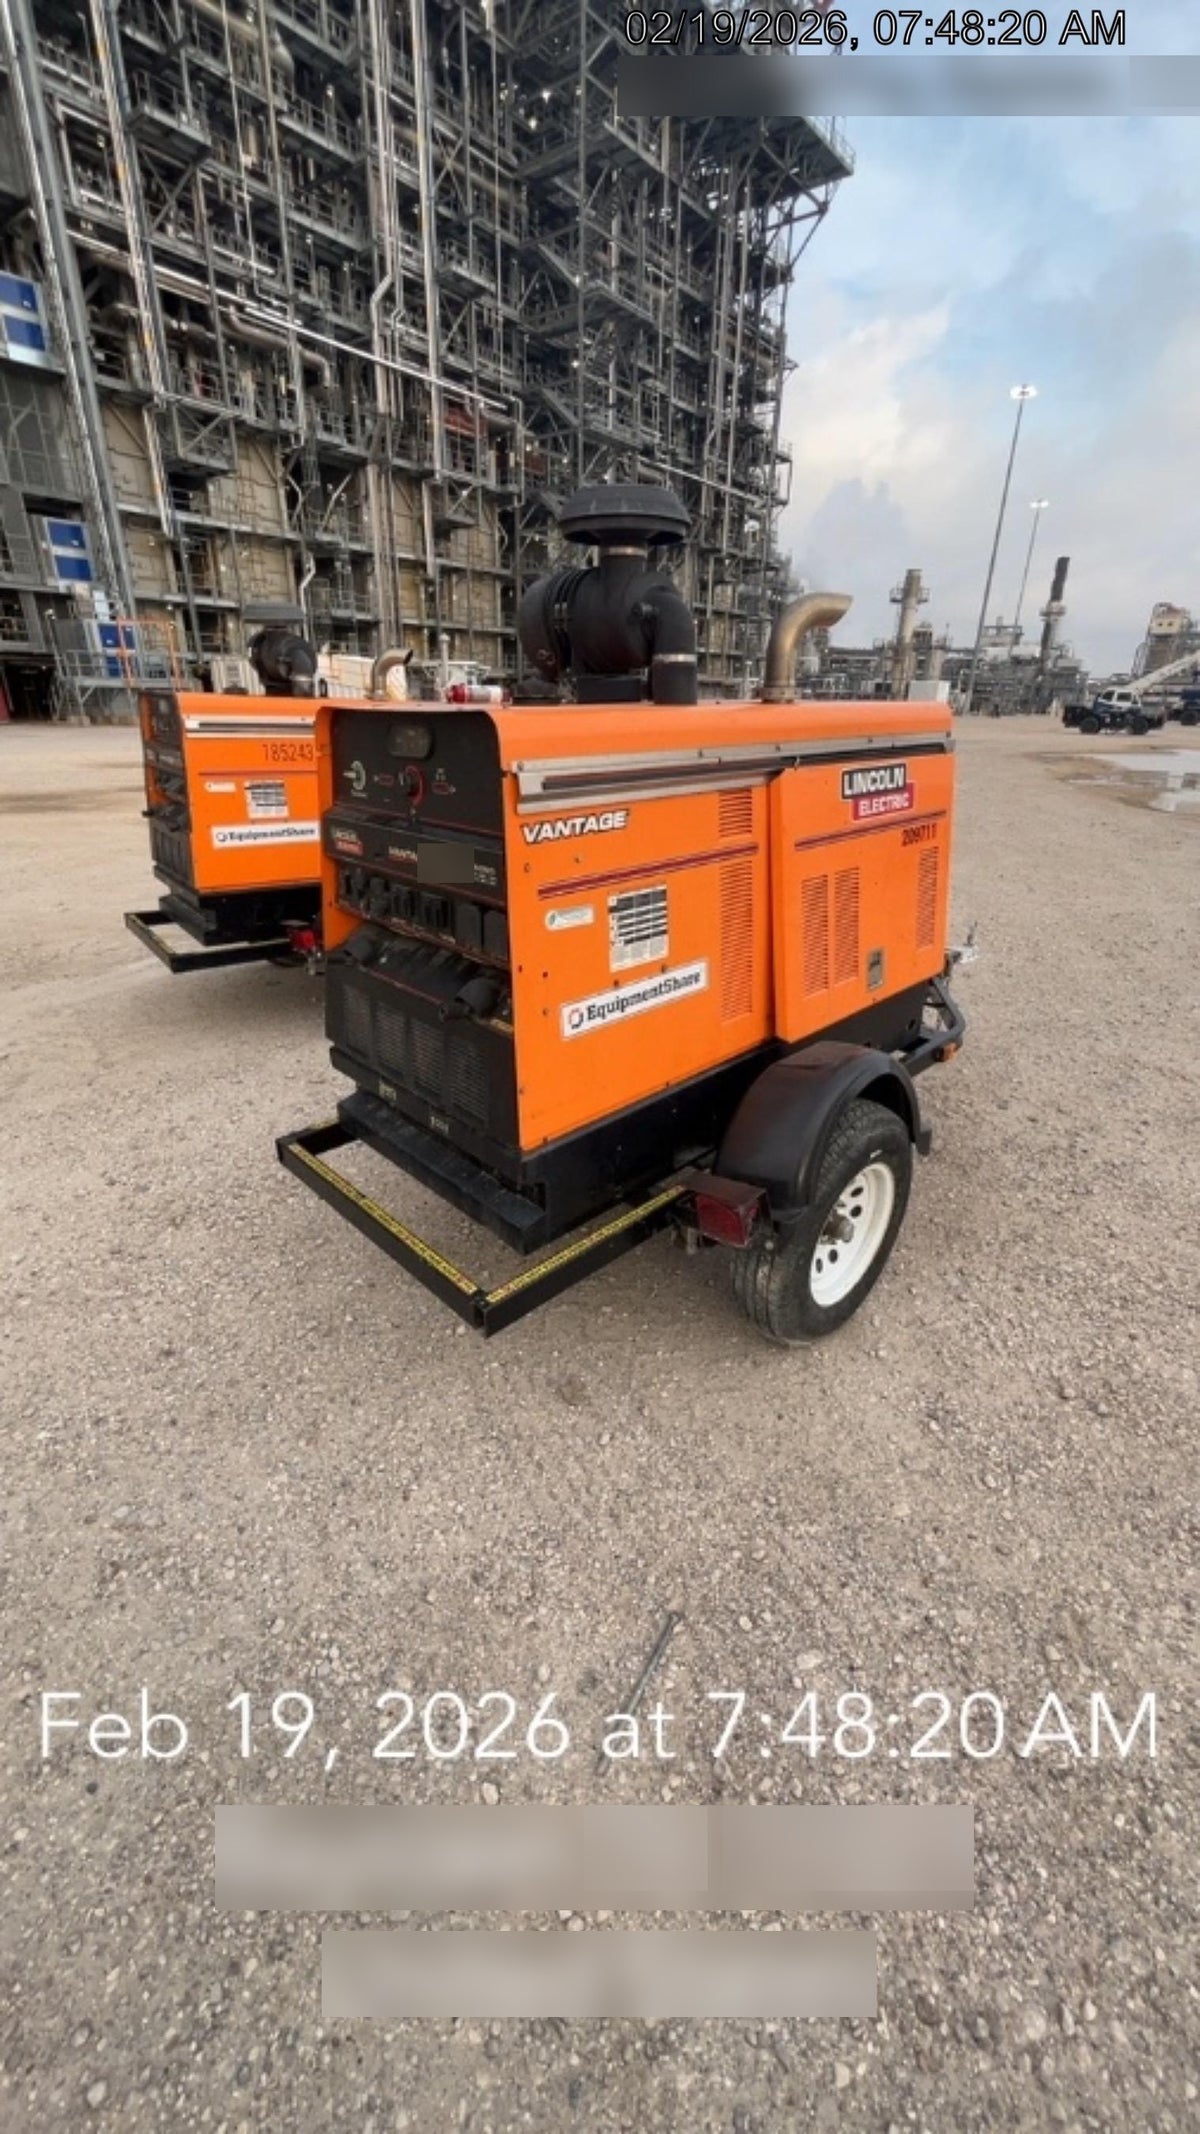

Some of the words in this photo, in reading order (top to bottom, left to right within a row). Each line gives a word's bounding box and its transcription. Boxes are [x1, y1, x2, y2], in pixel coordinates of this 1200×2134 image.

[262, 744, 314, 761] 185243
[843, 765, 905, 796] LINCOLN
[858, 793, 910, 817] ELECTRIC
[522, 809, 628, 843] VANTAGE
[586, 971, 702, 1021] EquipmentShare
